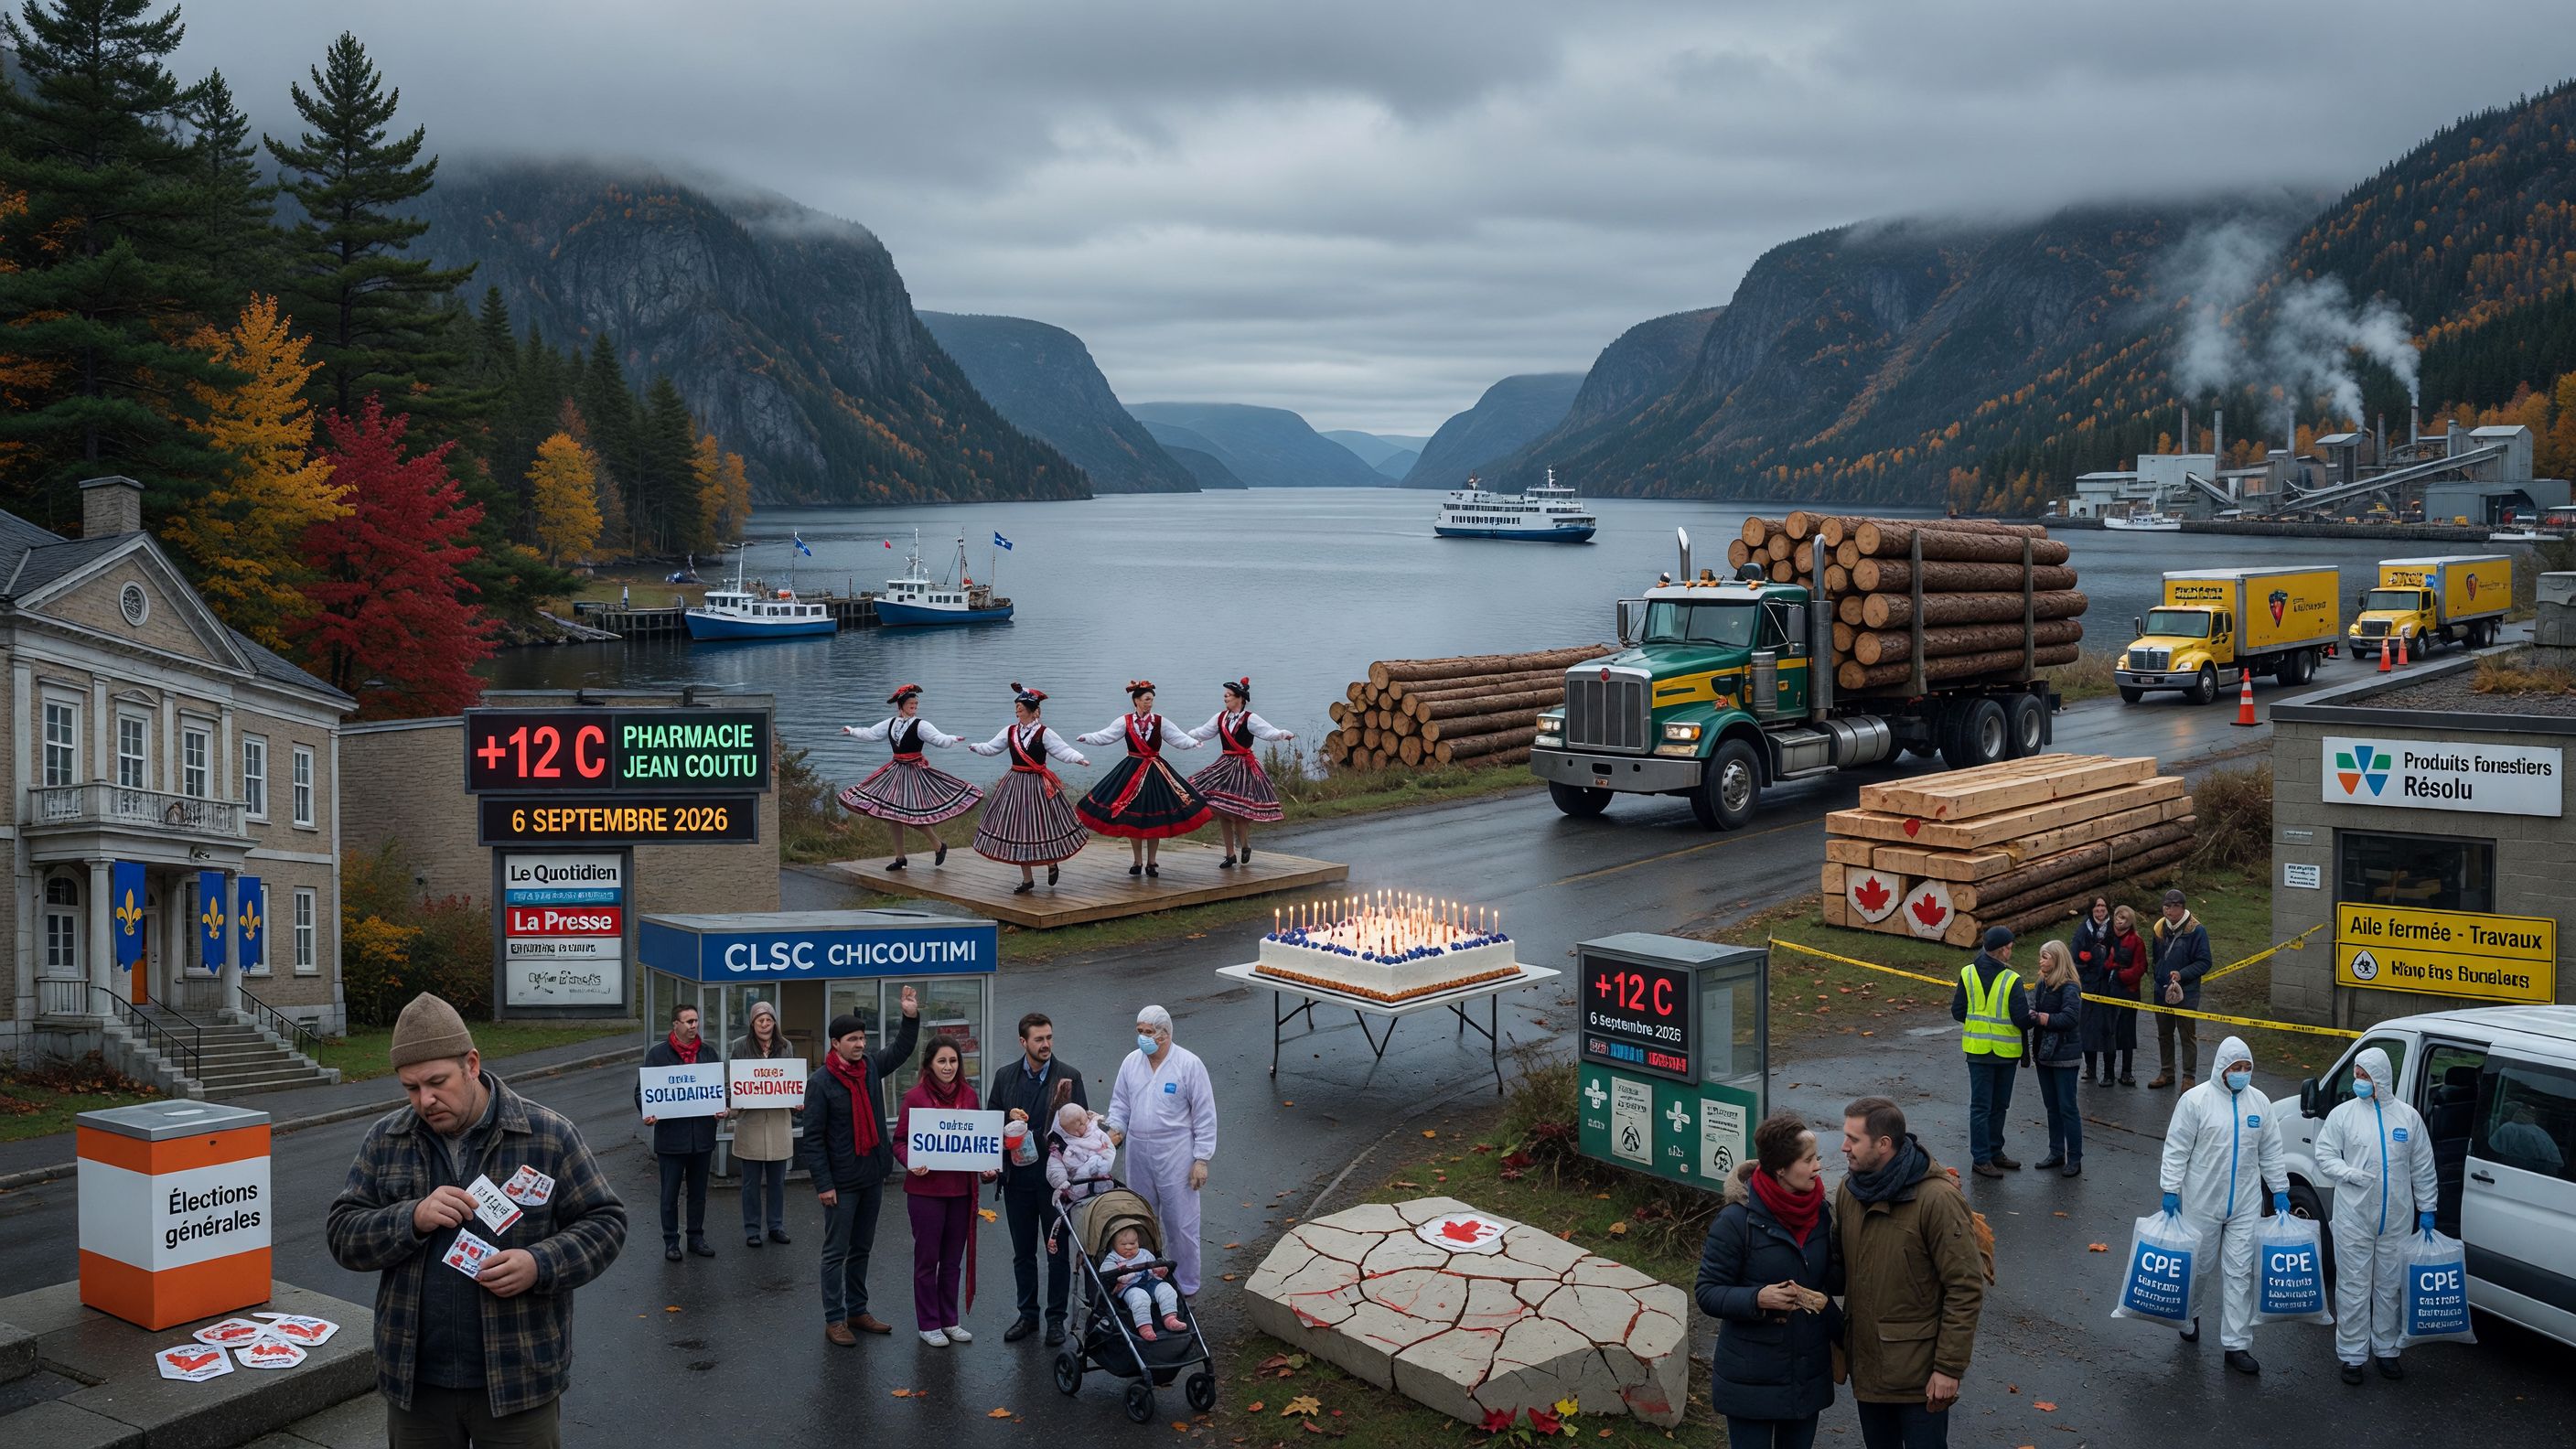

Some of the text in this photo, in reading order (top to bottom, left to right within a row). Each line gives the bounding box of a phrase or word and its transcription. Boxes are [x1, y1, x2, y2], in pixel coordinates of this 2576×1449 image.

[623, 724, 753, 748] PHARMACIE
[478, 725, 605, 778] +12 C
[2404, 751, 2469, 772] Produits
[623, 755, 757, 778] JEAN COUTU
[2404, 776, 2472, 800] Résolu
[512, 807, 728, 832] 6 SEPTEMBRE 2026
[510, 864, 617, 884] Le Quotidien
[514, 910, 612, 931] La Presse
[2350, 917, 2382, 936] Aile
[2388, 918, 2452, 941] fermée
[2470, 925, 2542, 950] Travaux
[724, 940, 976, 971] CLSC CHICOUTIMI
[1595, 971, 1673, 1016] +12 C
[1590, 1012, 1597, 1025] 6
[1656, 1025, 1681, 1042] 2026
[913, 1132, 1000, 1154] SOLIDAIRE
[168, 1184, 258, 1215] Élections
[166, 1210, 261, 1249] générales
[2141, 1251, 2182, 1278] CPE
[2270, 1252, 2313, 1272] CPE
[2420, 1270, 2460, 1291] CPE
